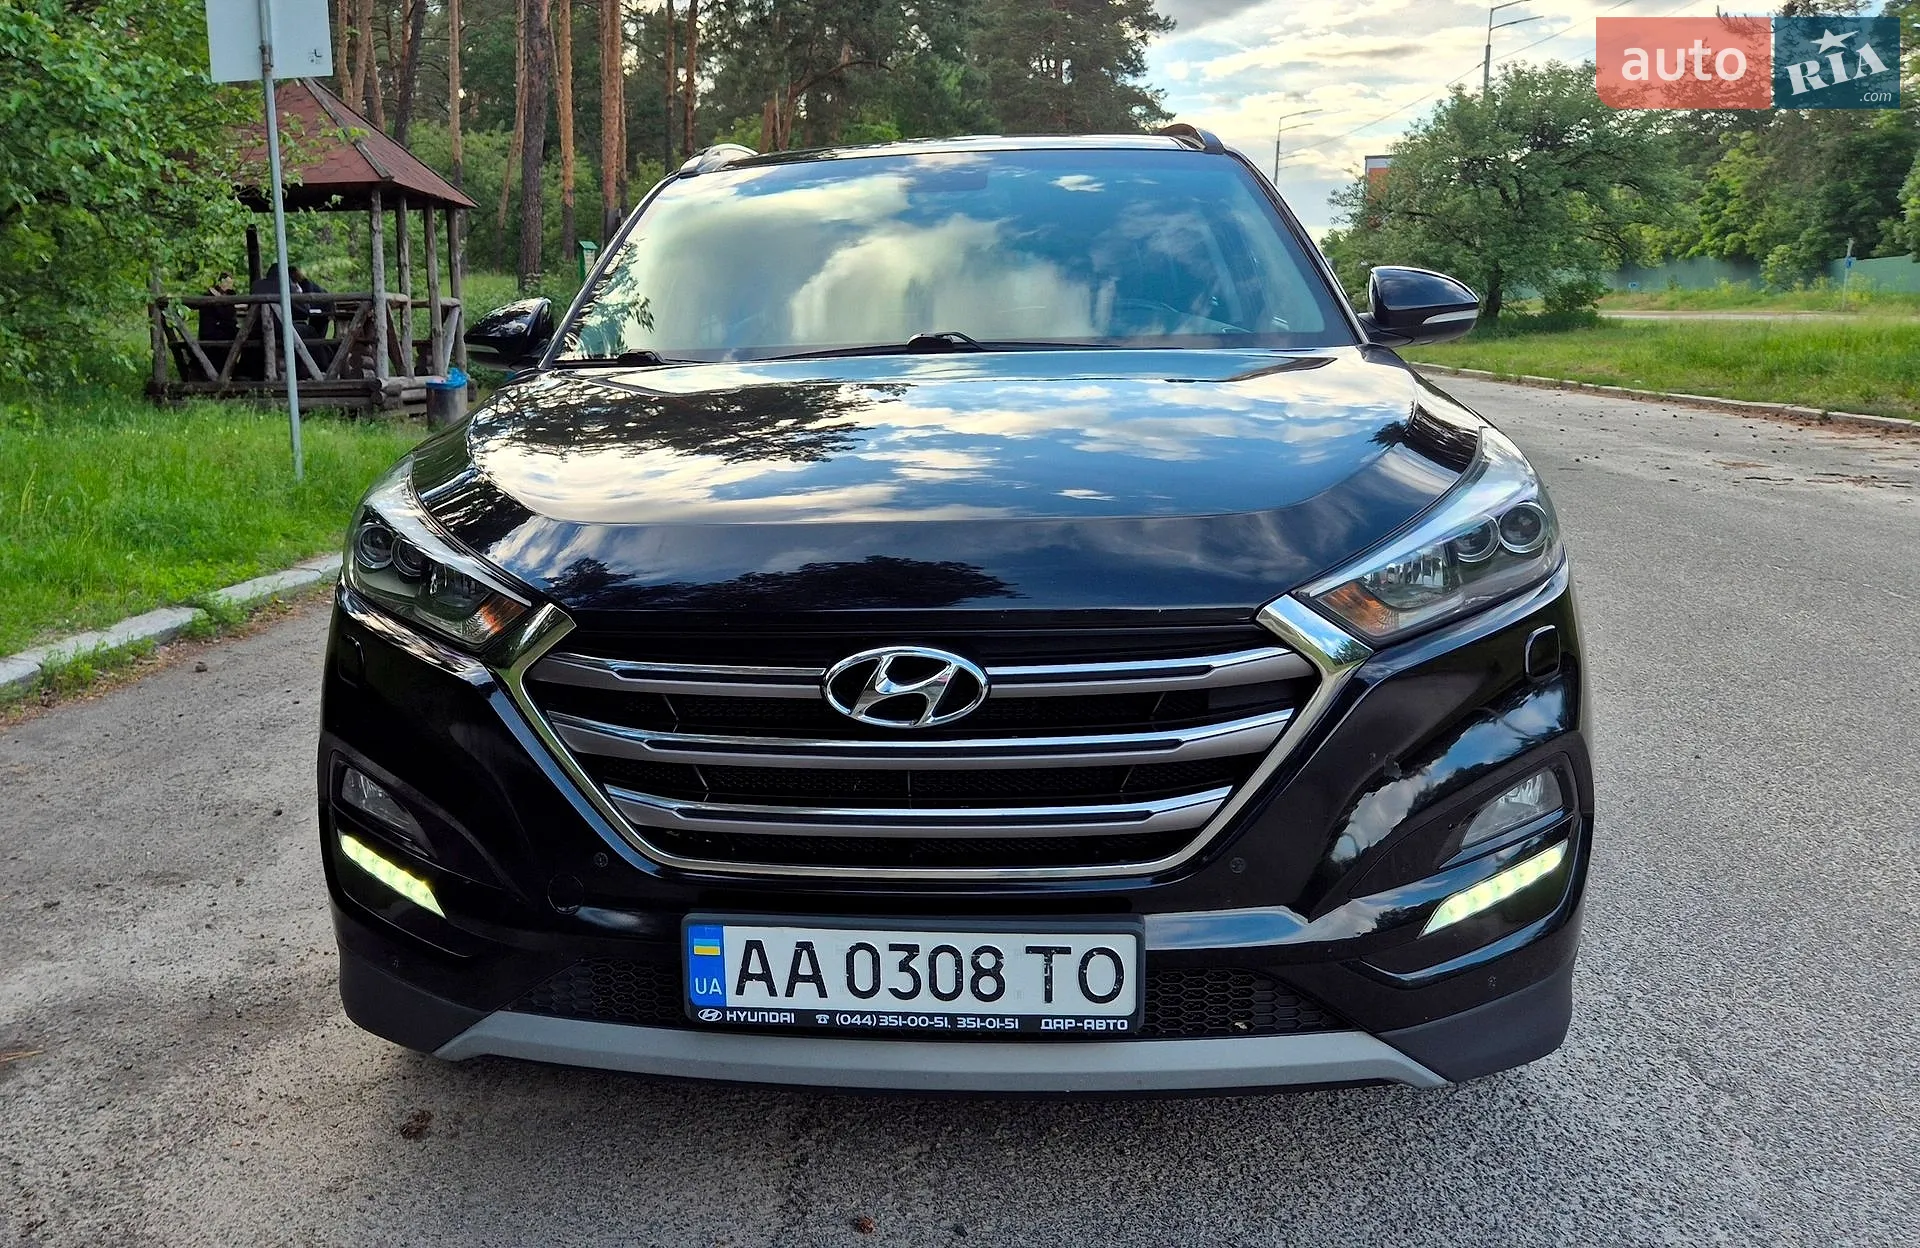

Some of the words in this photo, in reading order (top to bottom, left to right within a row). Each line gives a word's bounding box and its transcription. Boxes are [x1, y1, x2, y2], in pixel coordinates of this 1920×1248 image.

[735, 940, 828, 998] AA
[845, 942, 1006, 1003] 0308
[1025, 946, 1125, 1003] TO
[695, 977, 723, 996] UA
[726, 1010, 795, 1024] HYUNDAI
[957, 1017, 1019, 1030] 351-01-51
[1040, 1018, 1129, 1031] ДАР-АВТО
